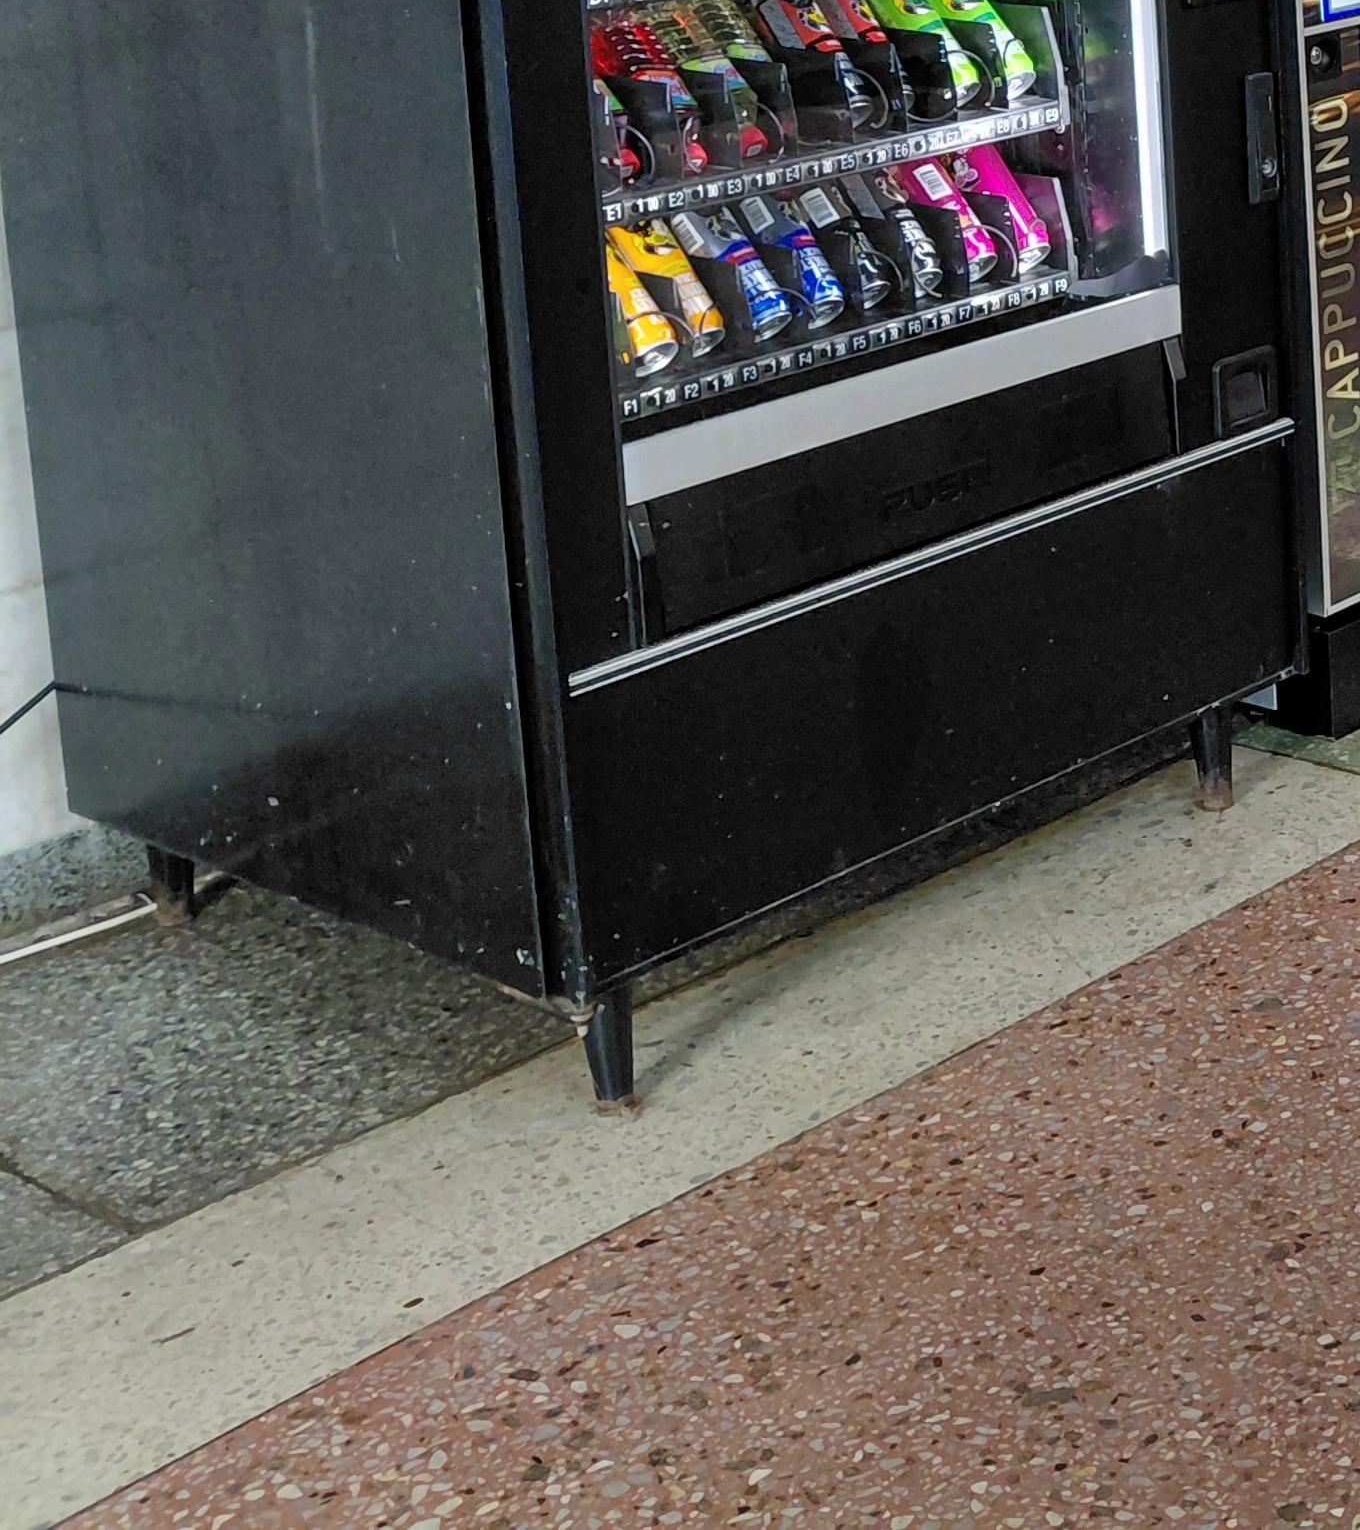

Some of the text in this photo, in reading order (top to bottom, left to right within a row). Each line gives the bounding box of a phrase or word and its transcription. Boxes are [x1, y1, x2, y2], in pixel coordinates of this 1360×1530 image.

[1045, 109, 1059, 122] E9
[996, 121, 1010, 134] E8
[895, 145, 909, 158] E6
[841, 155, 855, 169] E5
[786, 168, 802, 183] E4
[727, 181, 743, 195] E3
[668, 193, 685, 207] E2
[605, 204, 622, 221] E1
[1055, 278, 1068, 292] F9
[1007, 292, 1021, 306] F8
[958, 306, 972, 320] F7
[908, 320, 921, 334] F6
[835, 341, 847, 355] 20
[853, 335, 867, 349] F5
[799, 353, 813, 367] F4
[723, 374, 734, 388] 20
[743, 367, 758, 381] F3
[664, 389, 676, 404] 20
[684, 384, 699, 399] F2
[623, 399, 638, 416] F1
